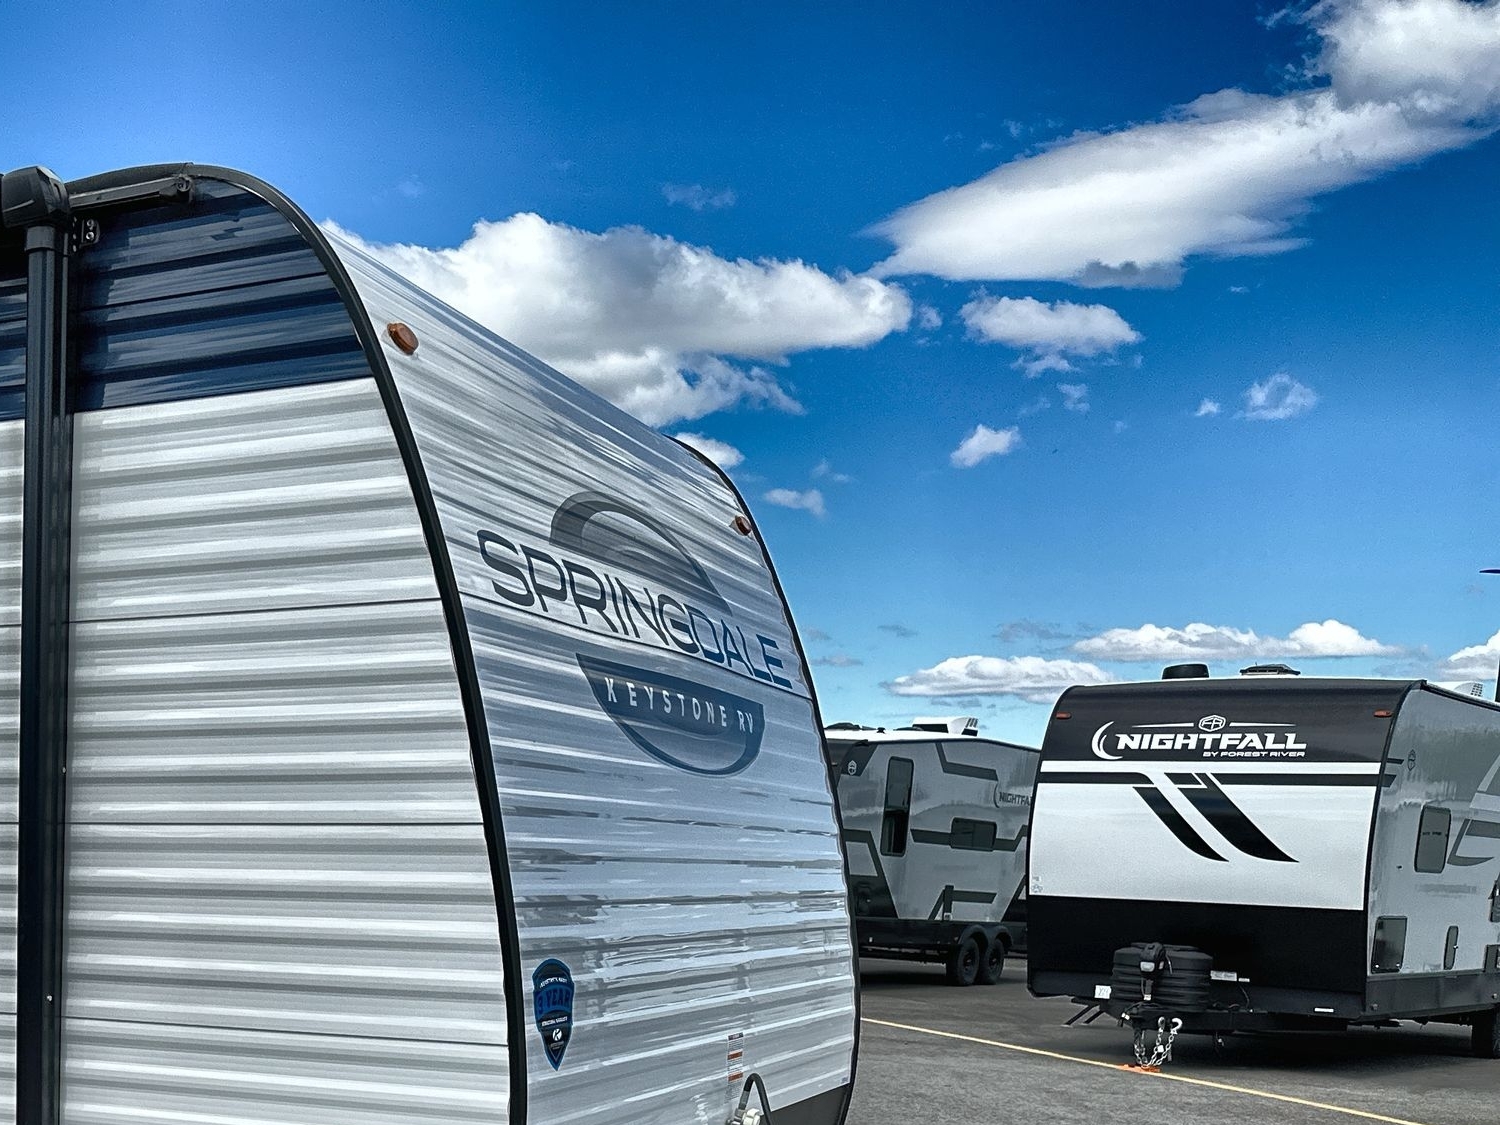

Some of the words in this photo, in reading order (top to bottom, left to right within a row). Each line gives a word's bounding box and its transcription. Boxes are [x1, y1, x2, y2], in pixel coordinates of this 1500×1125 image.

[476, 529, 793, 689] SPRINGDALE
[604, 677, 728, 728] KEYSTONE
[736, 709, 754, 734] RV
[1115, 732, 1308, 750] NIGHTFALL
[999, 791, 1032, 806] NIGHTFA
